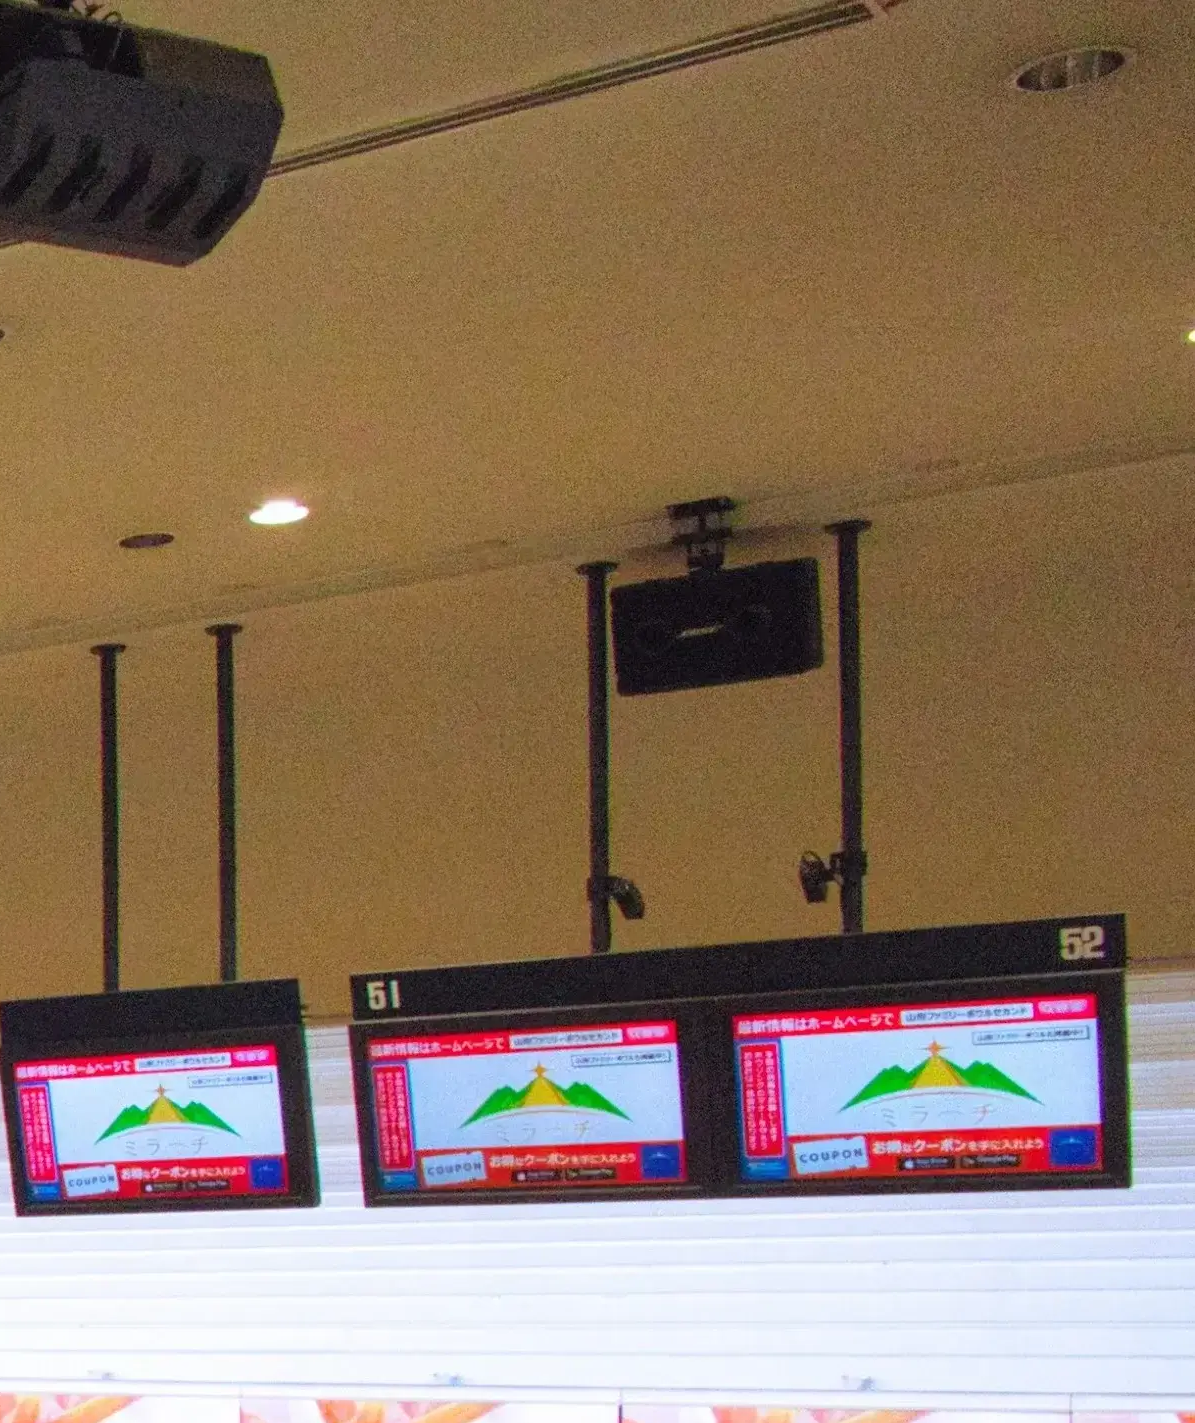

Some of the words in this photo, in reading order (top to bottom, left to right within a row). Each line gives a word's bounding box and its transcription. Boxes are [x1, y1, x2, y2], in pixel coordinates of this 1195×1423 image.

[1059, 925, 1104, 960] 52
[366, 980, 400, 1010] 51
[799, 1148, 863, 1164] COUPON
[427, 1162, 481, 1176] COUPON
[68, 1174, 115, 1188] COUPON
